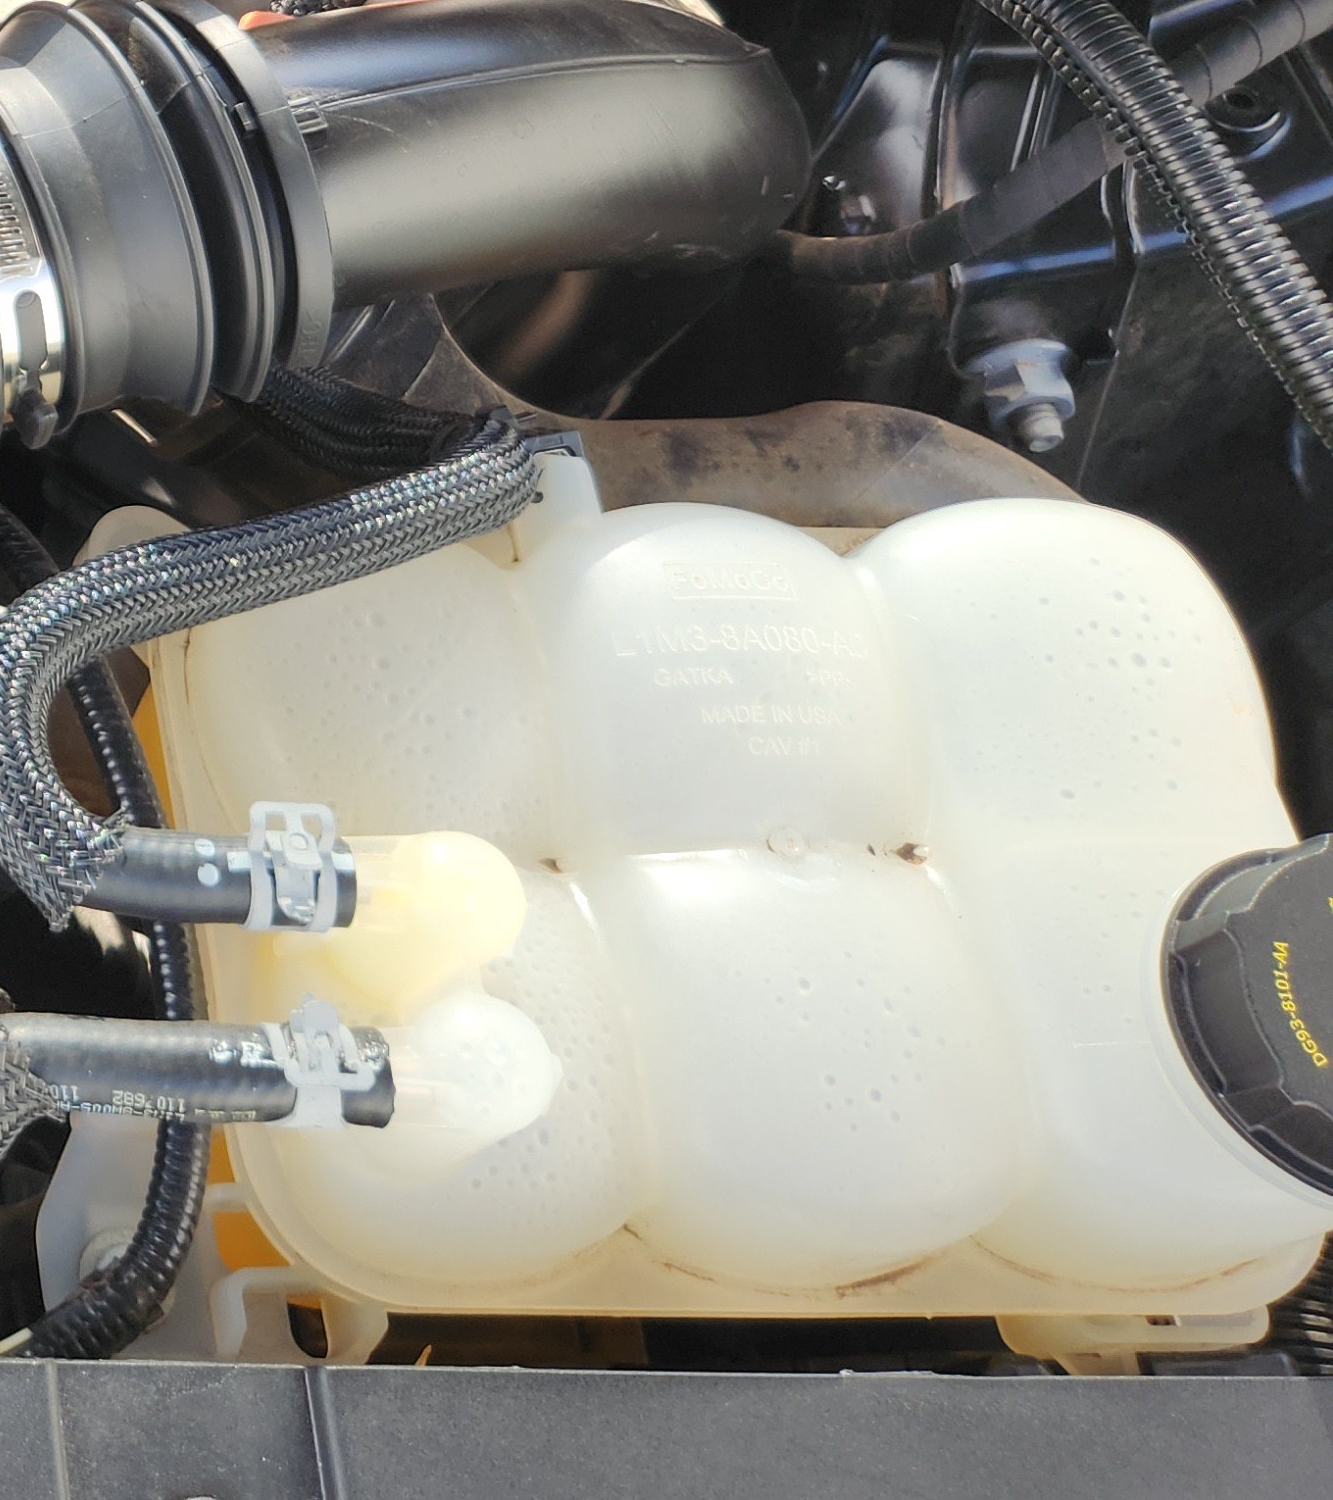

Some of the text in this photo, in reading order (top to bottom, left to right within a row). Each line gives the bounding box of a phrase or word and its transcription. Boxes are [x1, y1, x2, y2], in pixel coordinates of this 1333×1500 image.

[701, 703, 842, 726] MADE IN USA
[748, 735, 793, 756] CAV
[1270, 940, 1329, 1069] DG93-8101-AA
